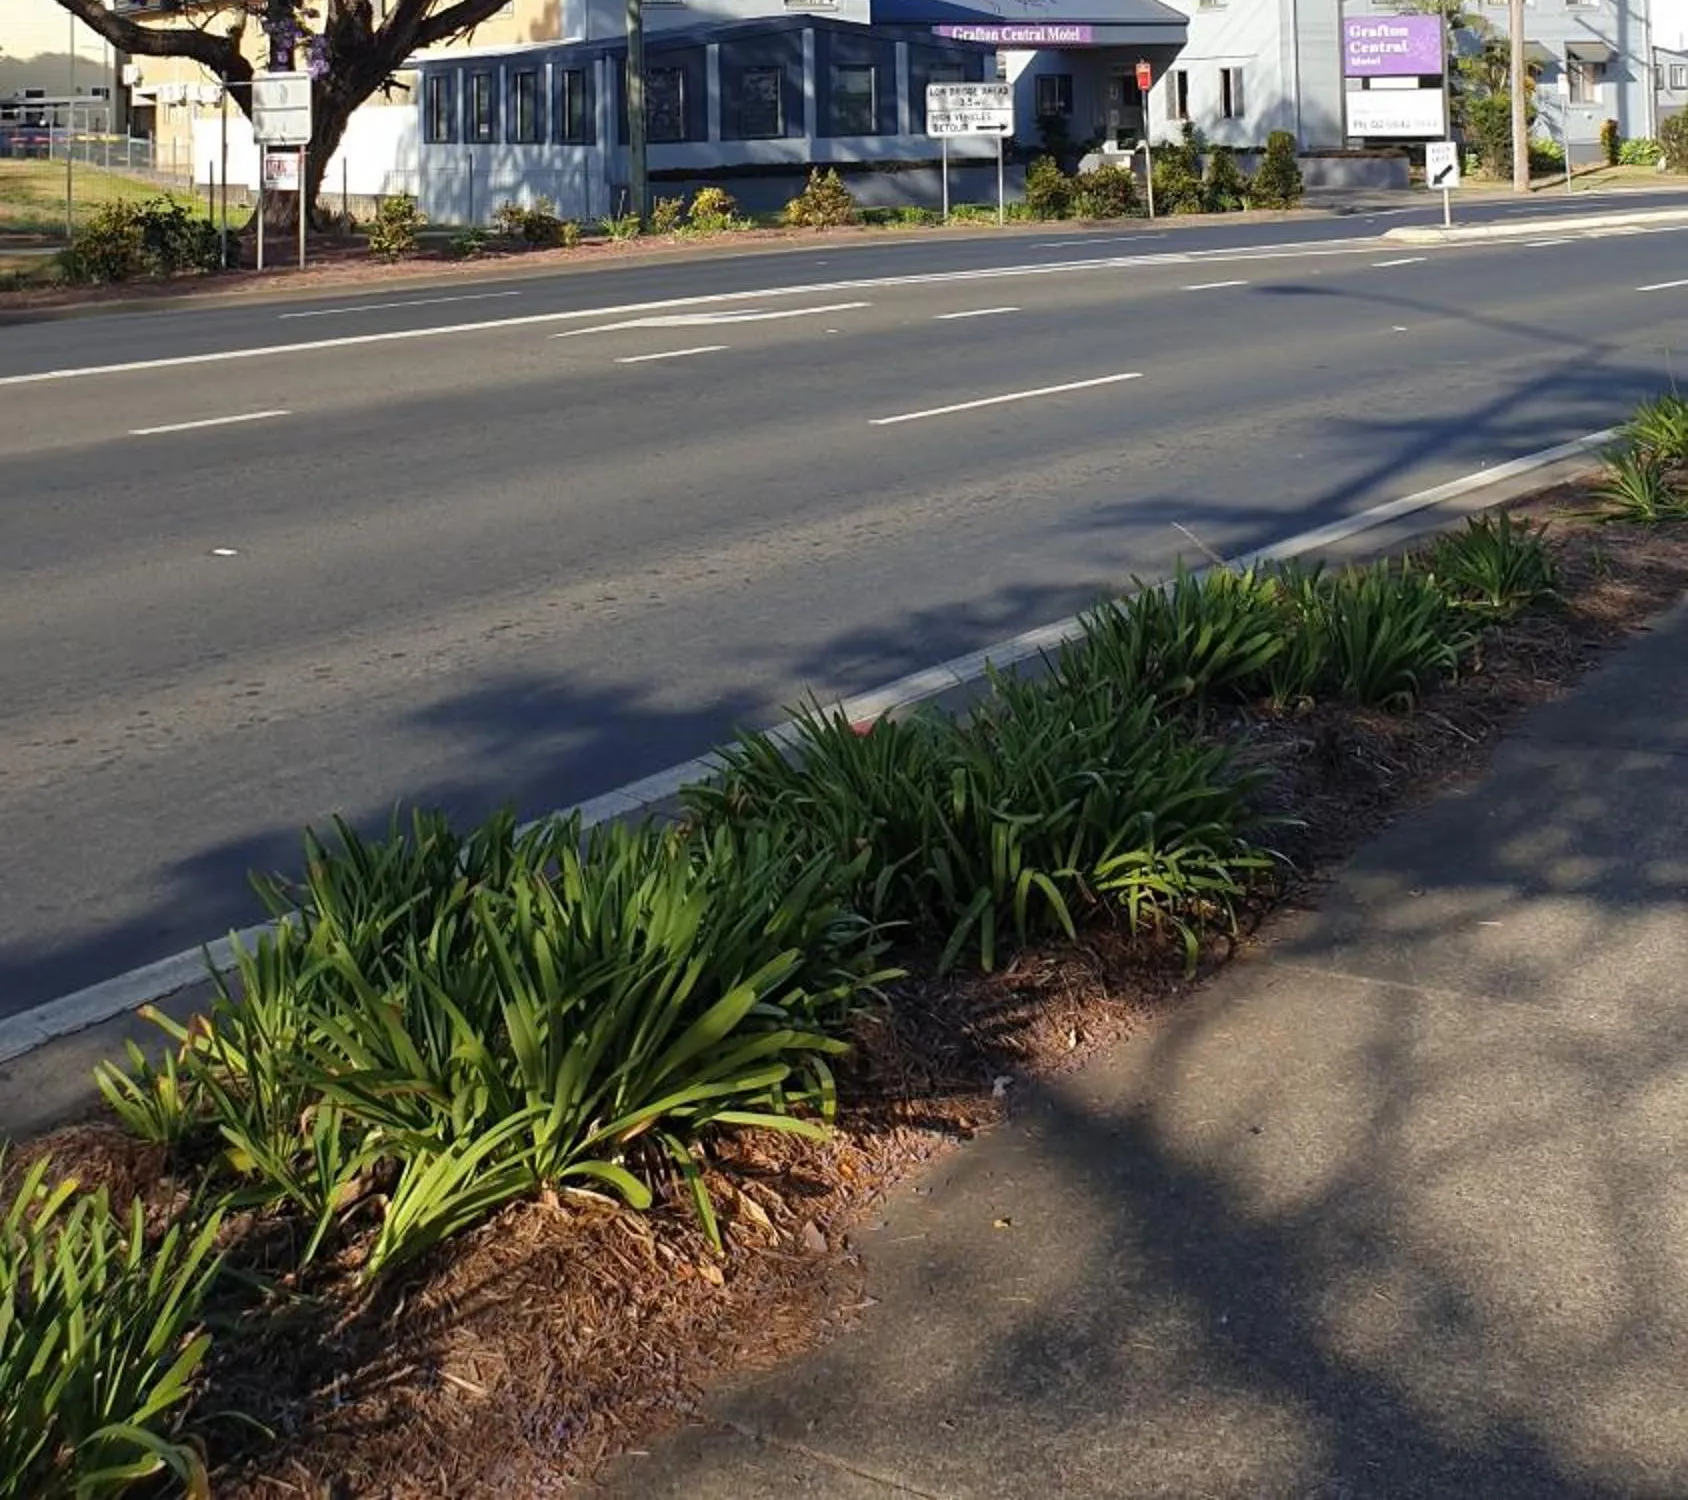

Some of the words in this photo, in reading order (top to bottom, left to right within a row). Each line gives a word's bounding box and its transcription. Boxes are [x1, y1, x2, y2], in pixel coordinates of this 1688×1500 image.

[952, 26, 998, 41] Grafton
[1002, 27, 1044, 41] Central
[1047, 27, 1080, 41] Motel
[1349, 25, 1409, 37] Grafton
[1349, 40, 1408, 53] Central
[1351, 56, 1381, 66] Motel
